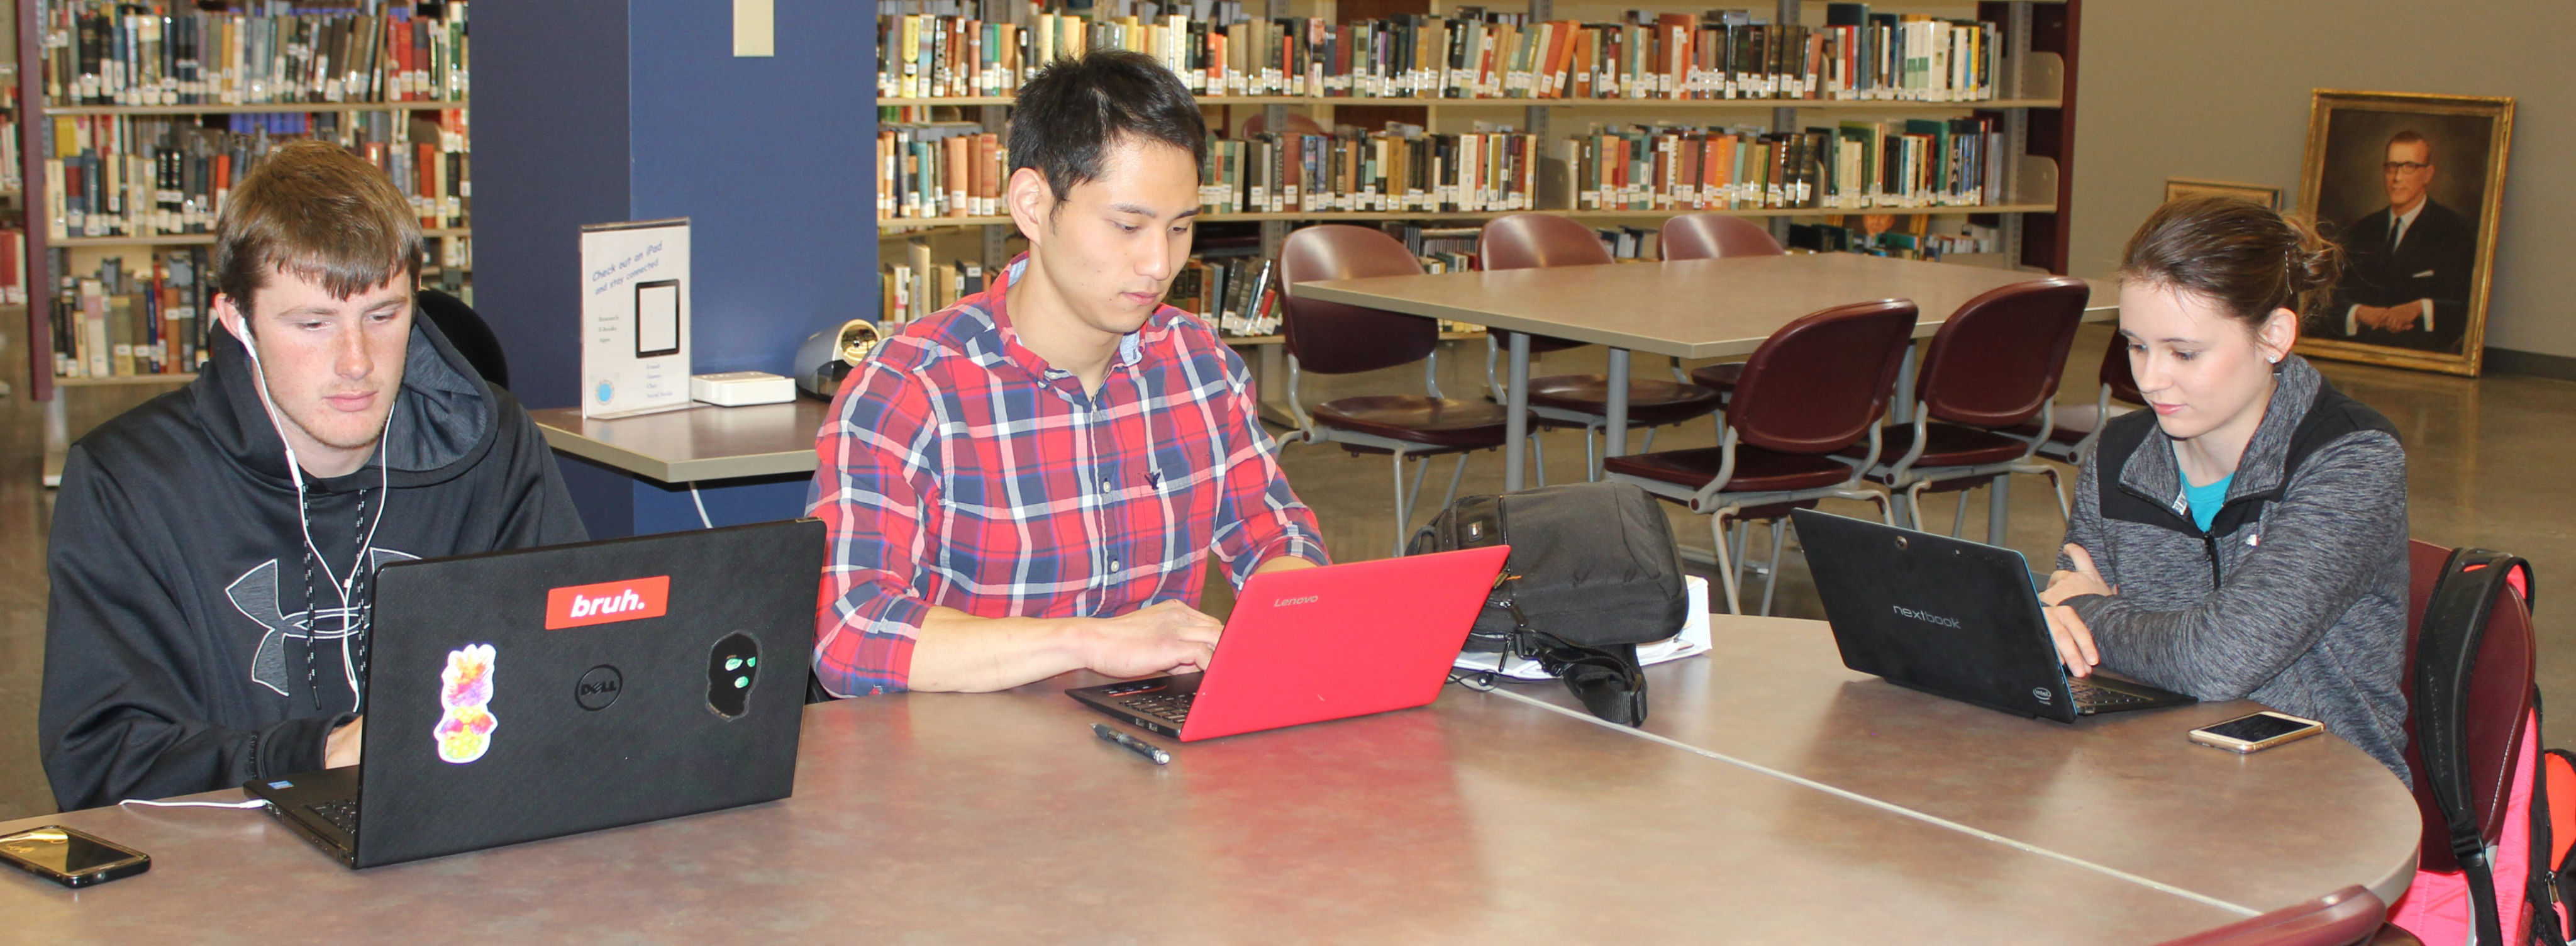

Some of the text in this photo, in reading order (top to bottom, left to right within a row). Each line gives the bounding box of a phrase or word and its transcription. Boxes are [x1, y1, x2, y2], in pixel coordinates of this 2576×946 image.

[593, 241, 662, 281] Check out an iPad
[596, 259, 658, 295] and stay connected
[570, 589, 645, 618] bruh.
[1274, 596, 1319, 607] Lenovo
[1892, 604, 1962, 630] nextbook
[580, 680, 617, 696] DELL
